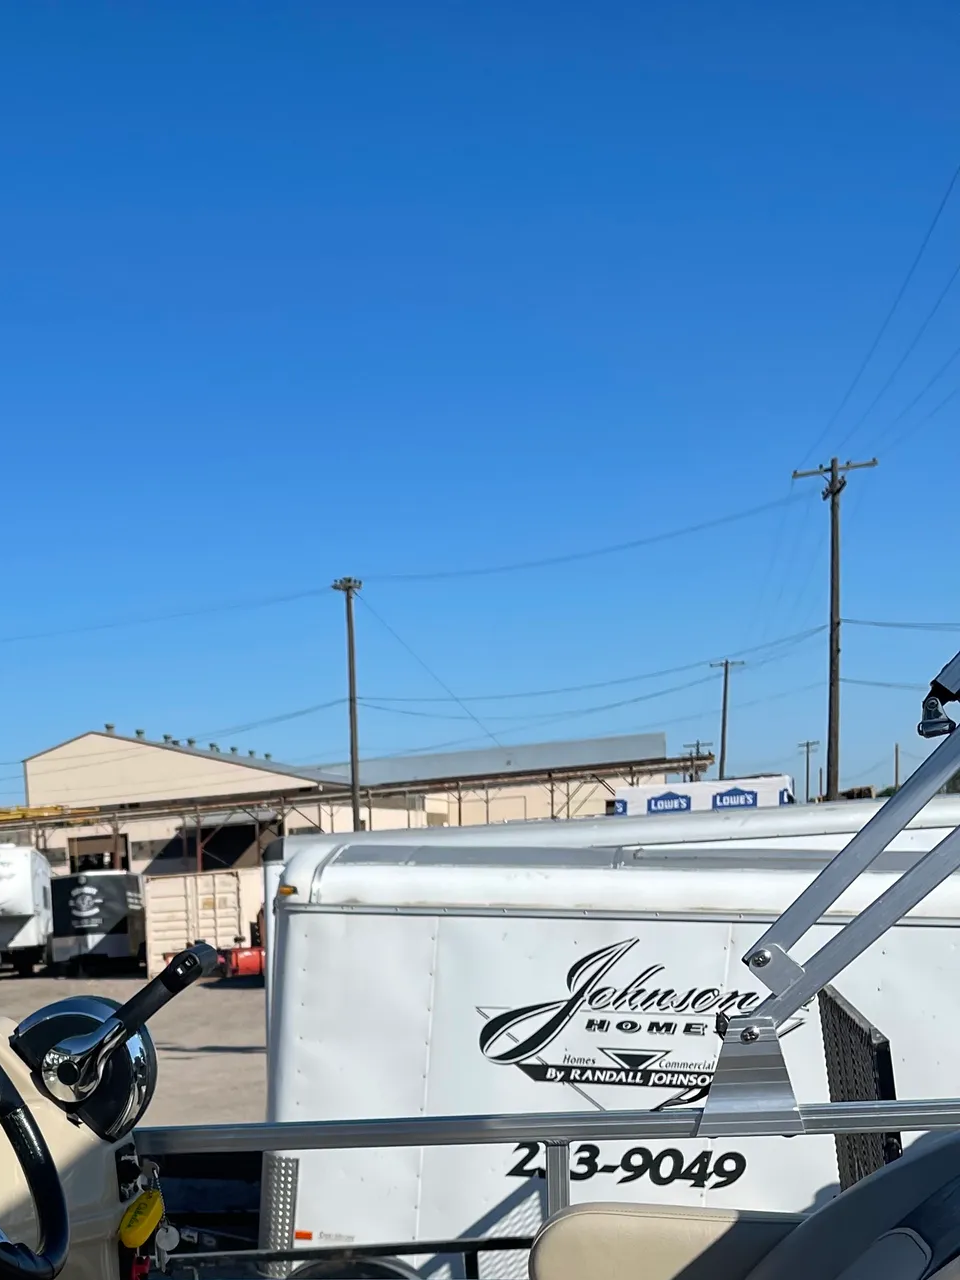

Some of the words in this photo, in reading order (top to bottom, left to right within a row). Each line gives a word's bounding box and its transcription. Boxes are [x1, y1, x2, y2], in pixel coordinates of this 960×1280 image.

[651, 797, 687, 810] LOWE'S
[716, 793, 754, 806] LOWE'S
[479, 936, 759, 1064] Johnson
[585, 1018, 709, 1036] HOME
[563, 1054, 597, 1066] Homes
[659, 1058, 715, 1070] Commercial
[546, 1068, 565, 1083] By
[569, 1069, 644, 1084] RANDALL
[648, 1071, 714, 1087] JOHNSO
[506, 1142, 747, 1190] 23-9049
